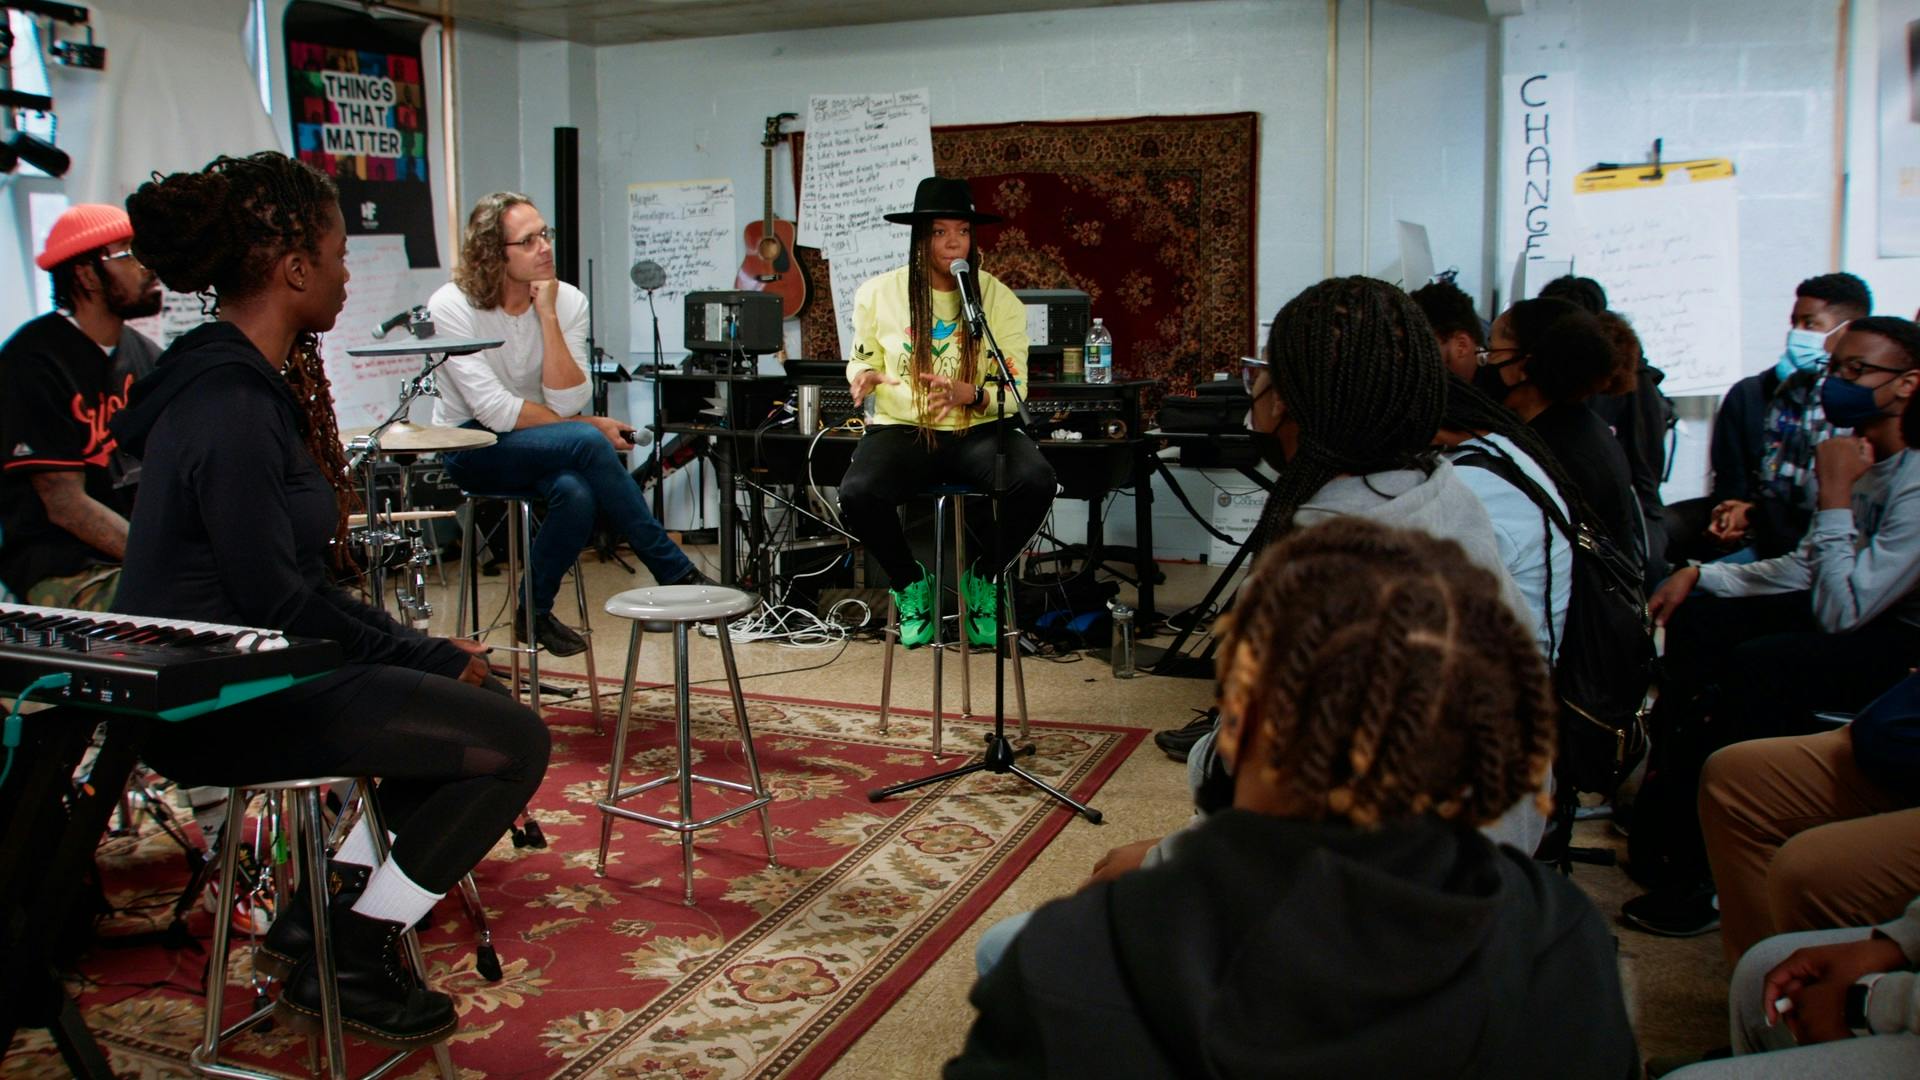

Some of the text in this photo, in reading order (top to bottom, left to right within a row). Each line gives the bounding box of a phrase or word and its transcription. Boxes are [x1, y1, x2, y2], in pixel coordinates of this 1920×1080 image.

[325, 76, 393, 100] THINGS
[338, 103, 385, 127] THAT
[326, 128, 400, 153] MATTER
[1520, 75, 1550, 260] CHANGE
